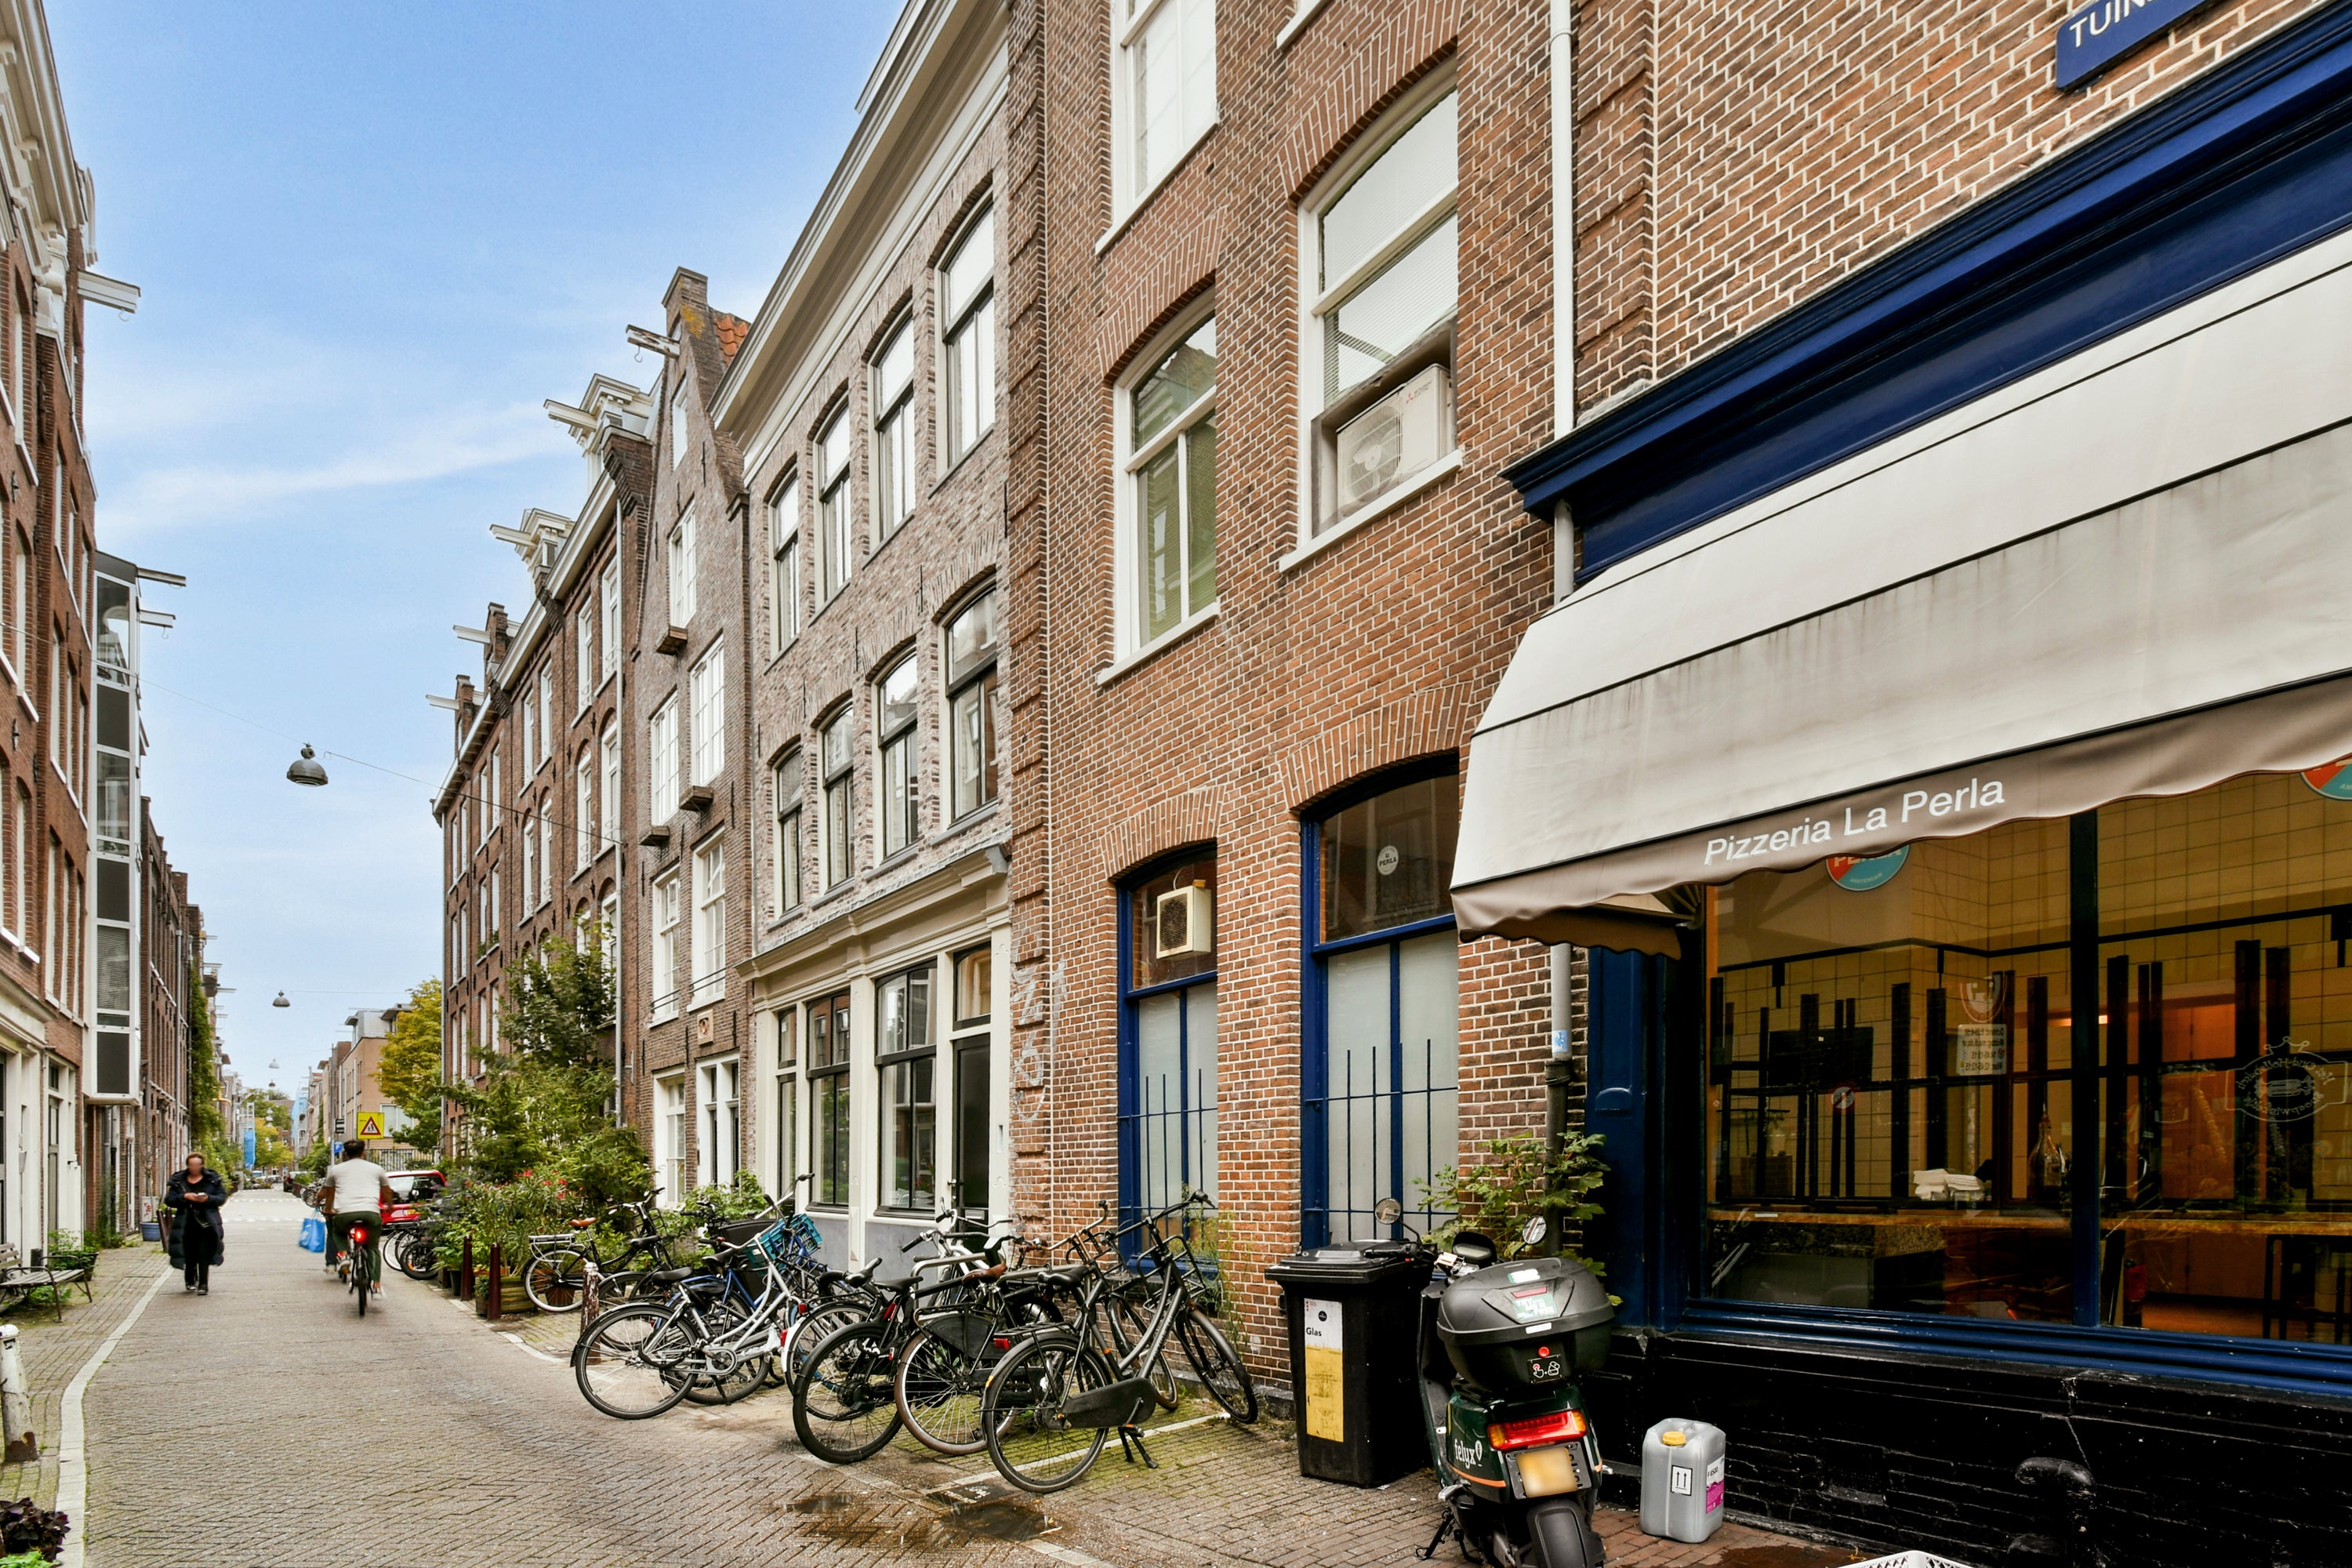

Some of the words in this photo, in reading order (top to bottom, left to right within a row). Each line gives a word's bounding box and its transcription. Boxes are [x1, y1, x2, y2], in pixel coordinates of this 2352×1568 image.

[2069, 0, 2148, 47] TUIN
[1704, 817, 1831, 866] Pizzeria
[1843, 807, 1888, 836] La
[1900, 777, 2005, 822] Perla
[1379, 856, 1397, 866] PERLA
[1305, 1327, 1322, 1337] Glas
[1454, 1438, 1476, 1469] felyx
